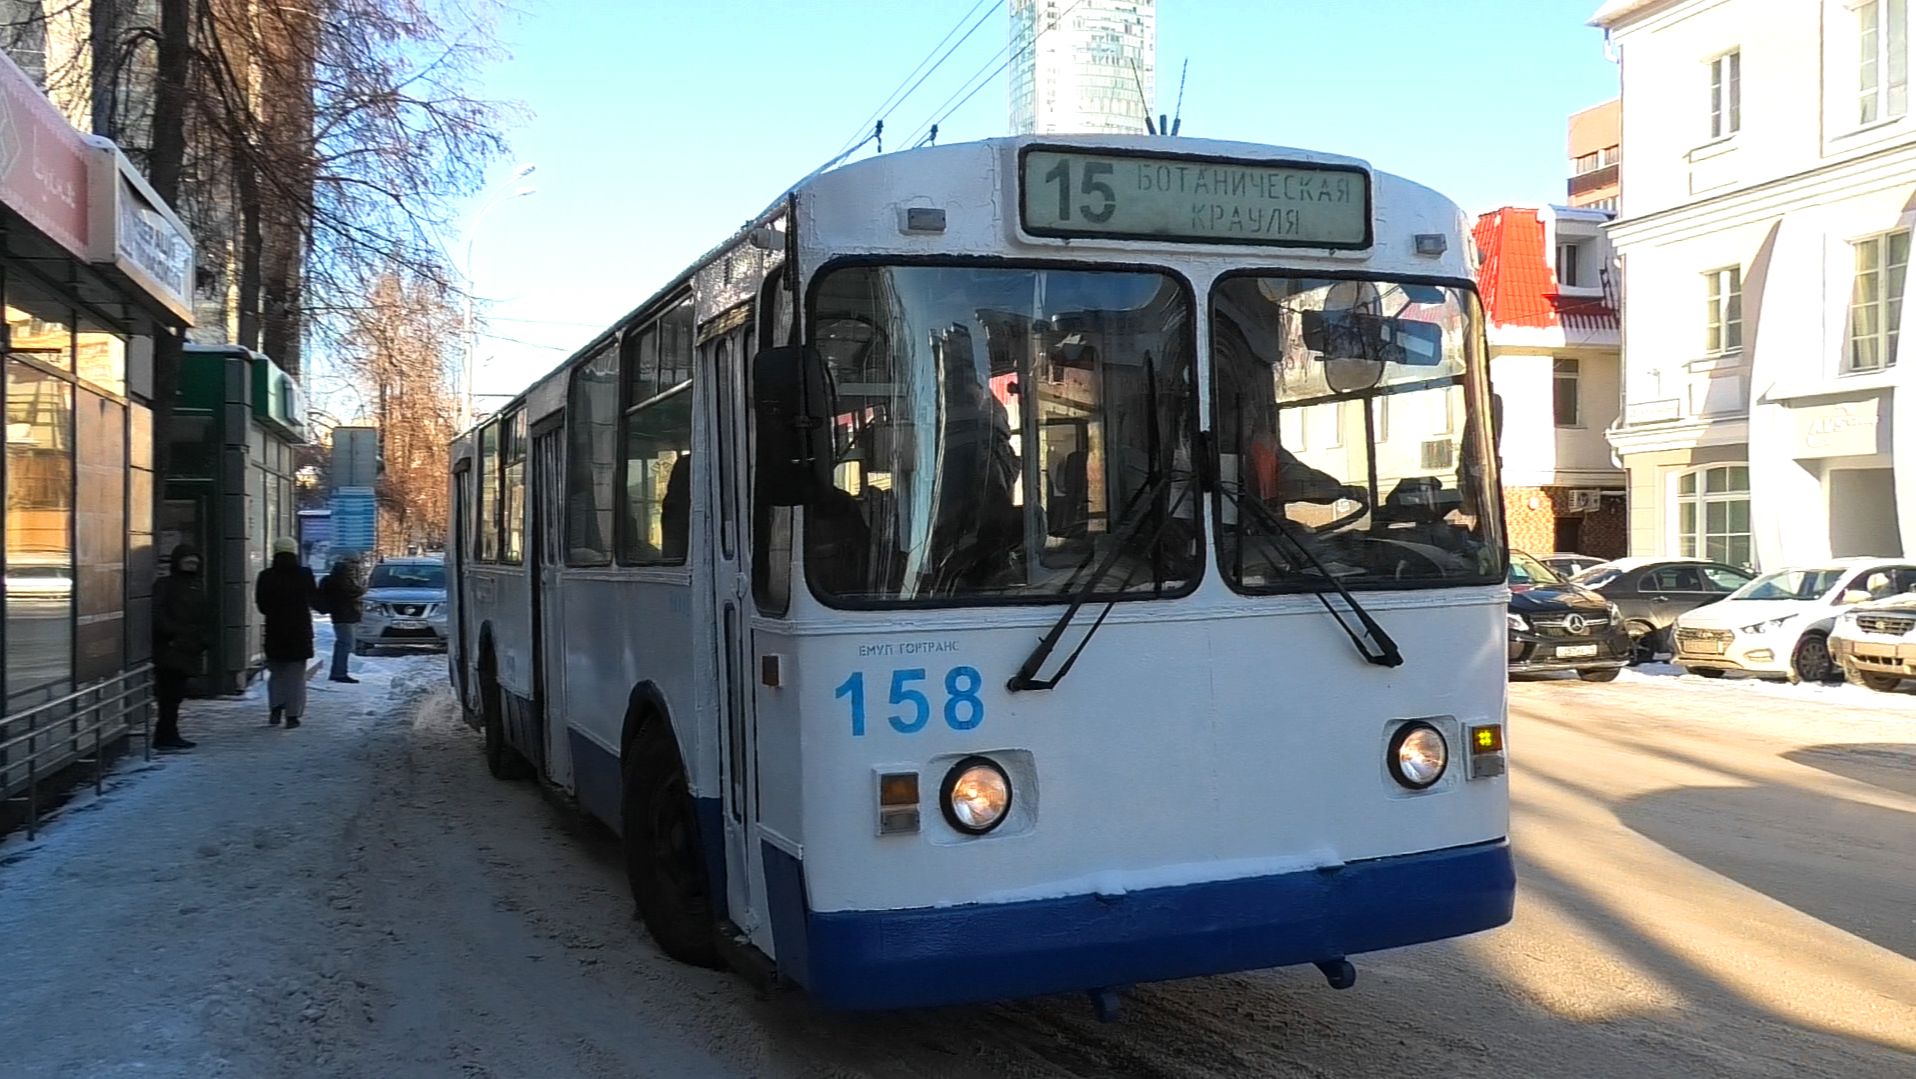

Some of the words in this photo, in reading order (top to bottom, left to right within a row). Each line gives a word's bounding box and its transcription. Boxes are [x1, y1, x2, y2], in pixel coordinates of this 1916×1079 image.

[1045, 159, 1116, 224] 15
[1137, 164, 1350, 203] БОТАНИЧЕСКАЯ
[1192, 203, 1299, 235] КРАУЛЯ
[858, 644, 893, 657] ЕМУП
[899, 640, 960, 654] ГОРТРАНС
[835, 666, 984, 736] 158
